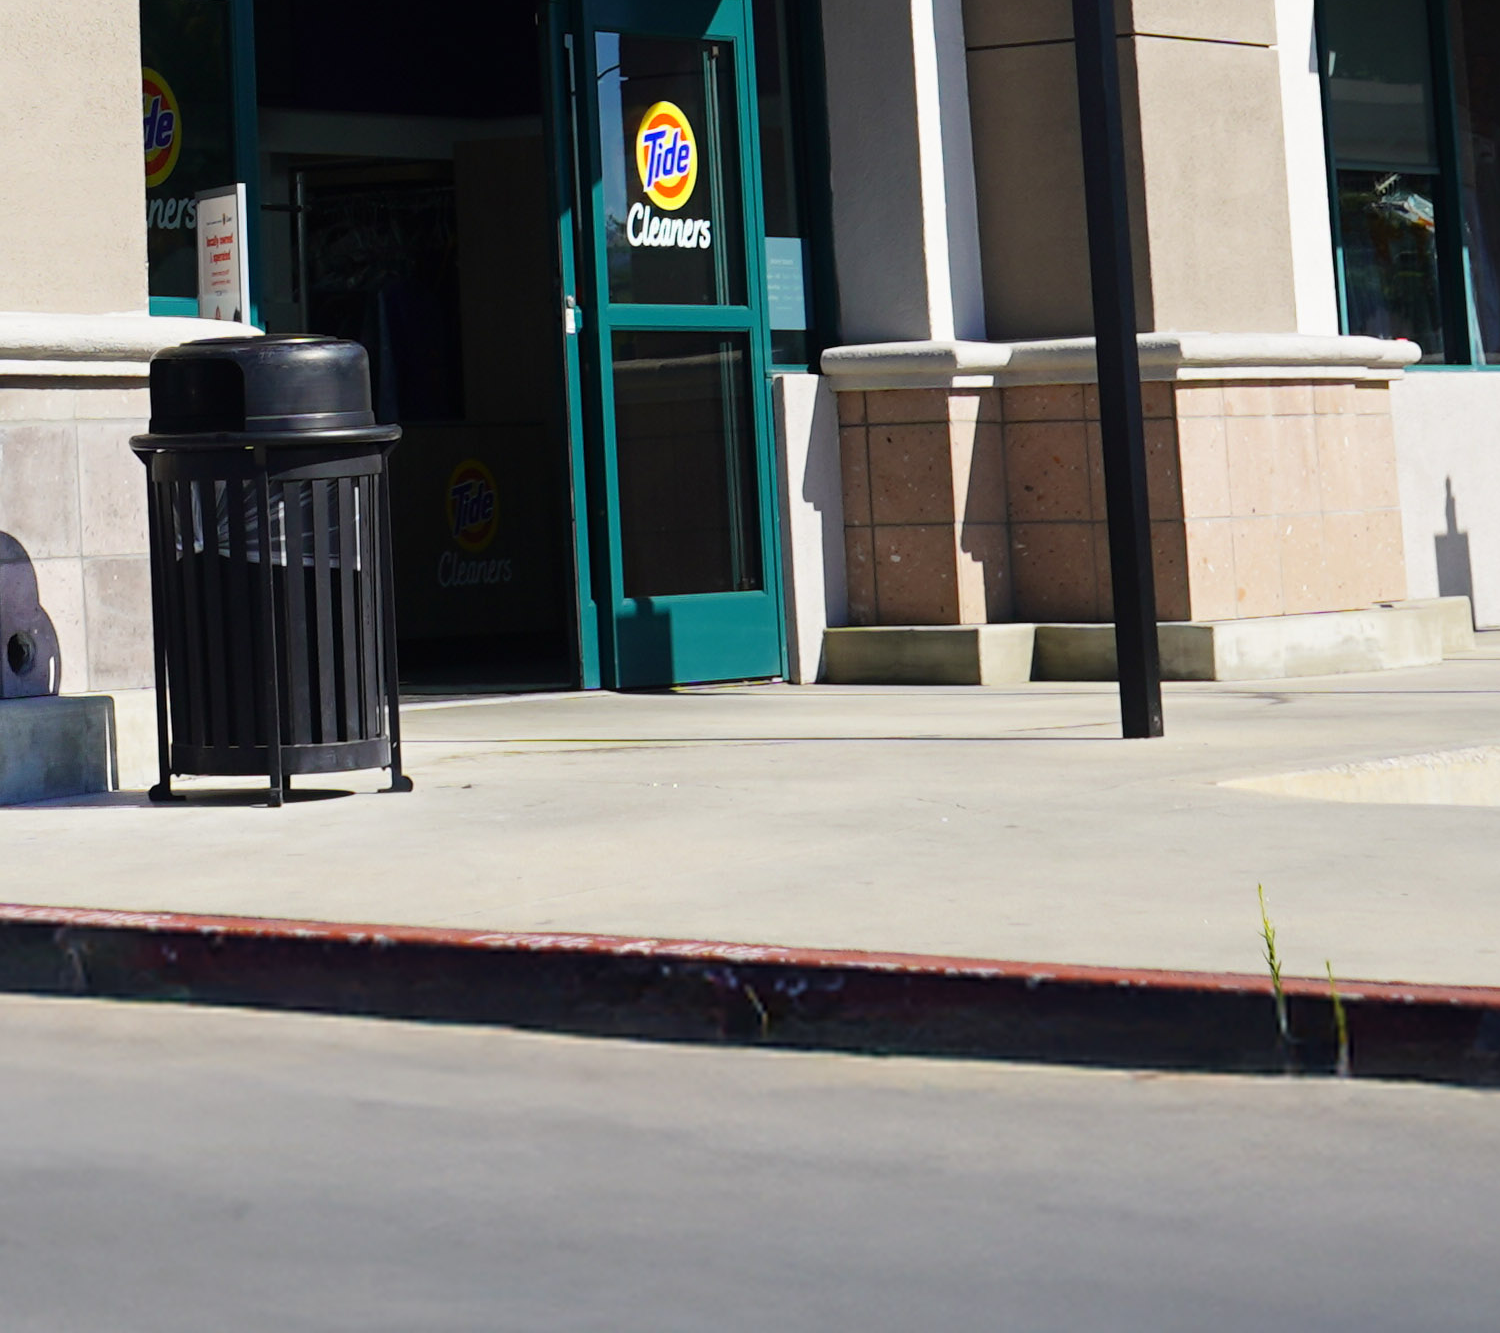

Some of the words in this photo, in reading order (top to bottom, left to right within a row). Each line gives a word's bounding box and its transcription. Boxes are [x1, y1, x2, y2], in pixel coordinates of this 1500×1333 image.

[143, 94, 176, 152] de
[643, 126, 690, 193] Tide
[147, 196, 198, 231] ners
[626, 202, 711, 249] Cleaners
[449, 478, 495, 539] Tide
[438, 550, 512, 588] Cleaners
